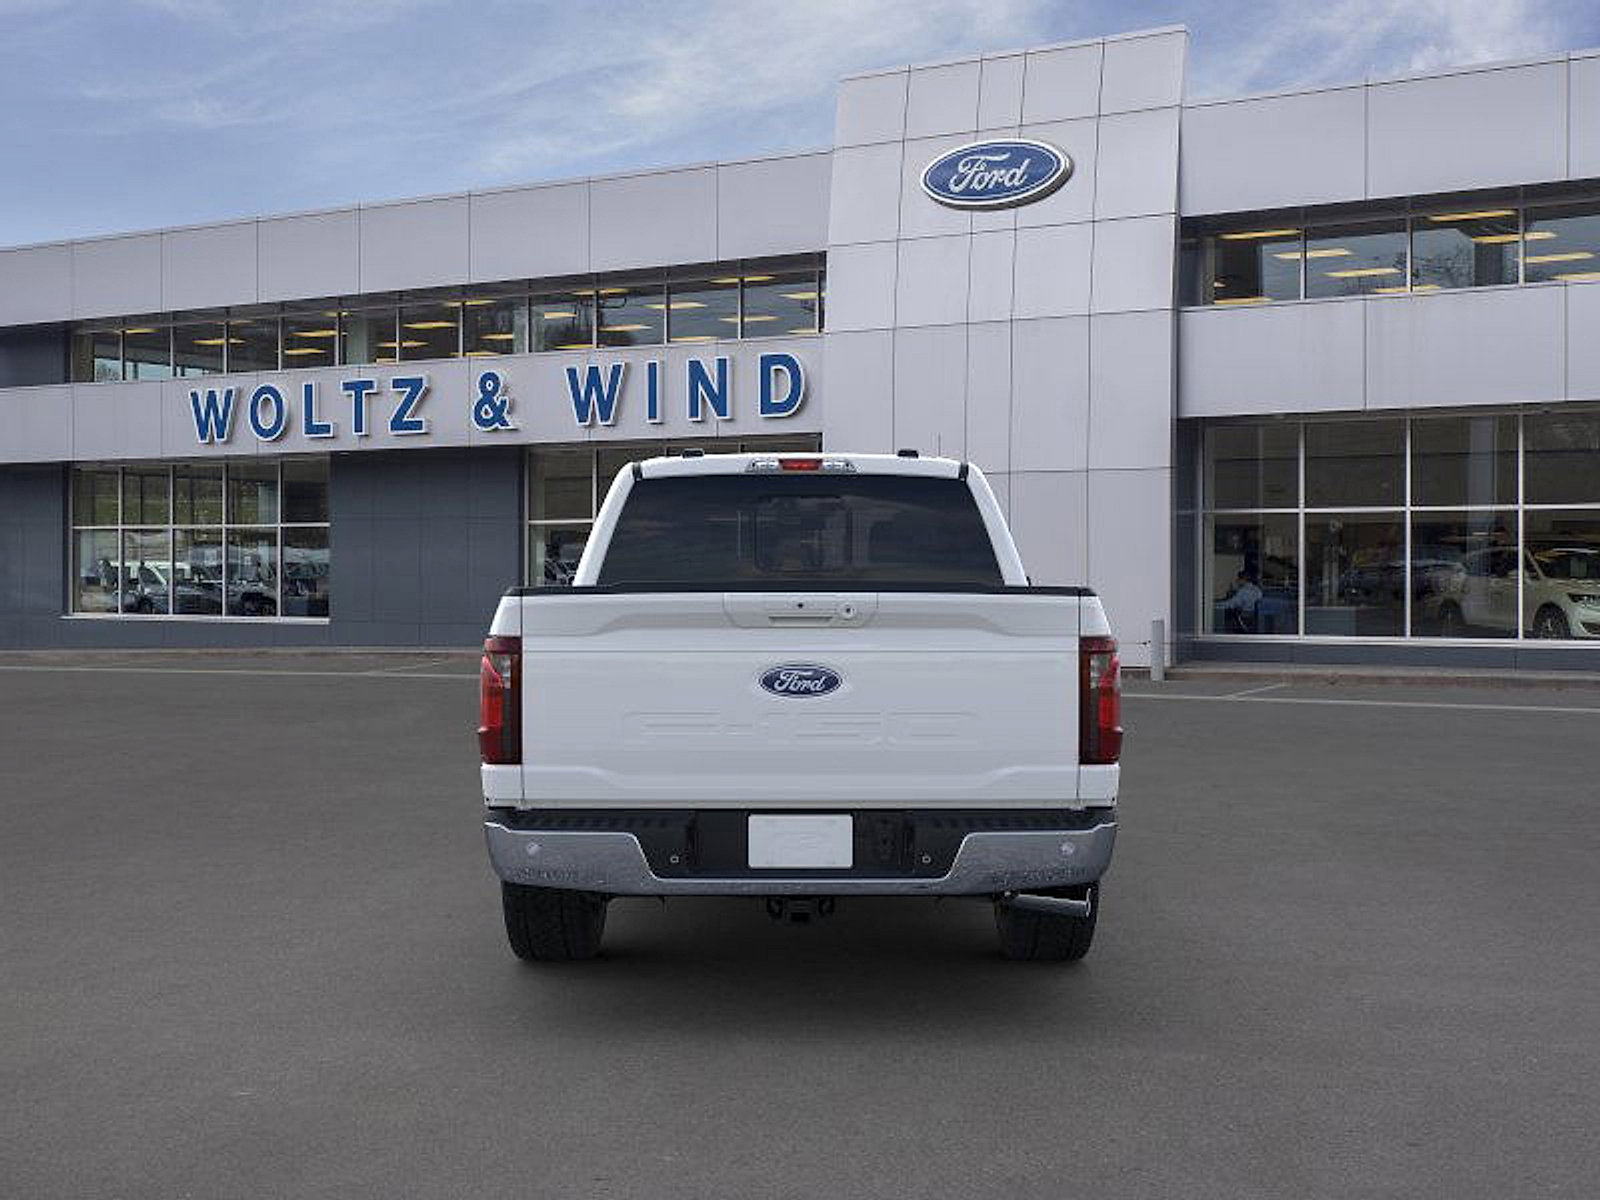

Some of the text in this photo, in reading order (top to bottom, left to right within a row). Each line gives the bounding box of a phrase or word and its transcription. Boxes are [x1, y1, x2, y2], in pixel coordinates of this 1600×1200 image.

[949, 152, 1031, 193] Ford
[189, 352, 806, 443] WOLTZ & WIND
[774, 670, 827, 691] Ford
